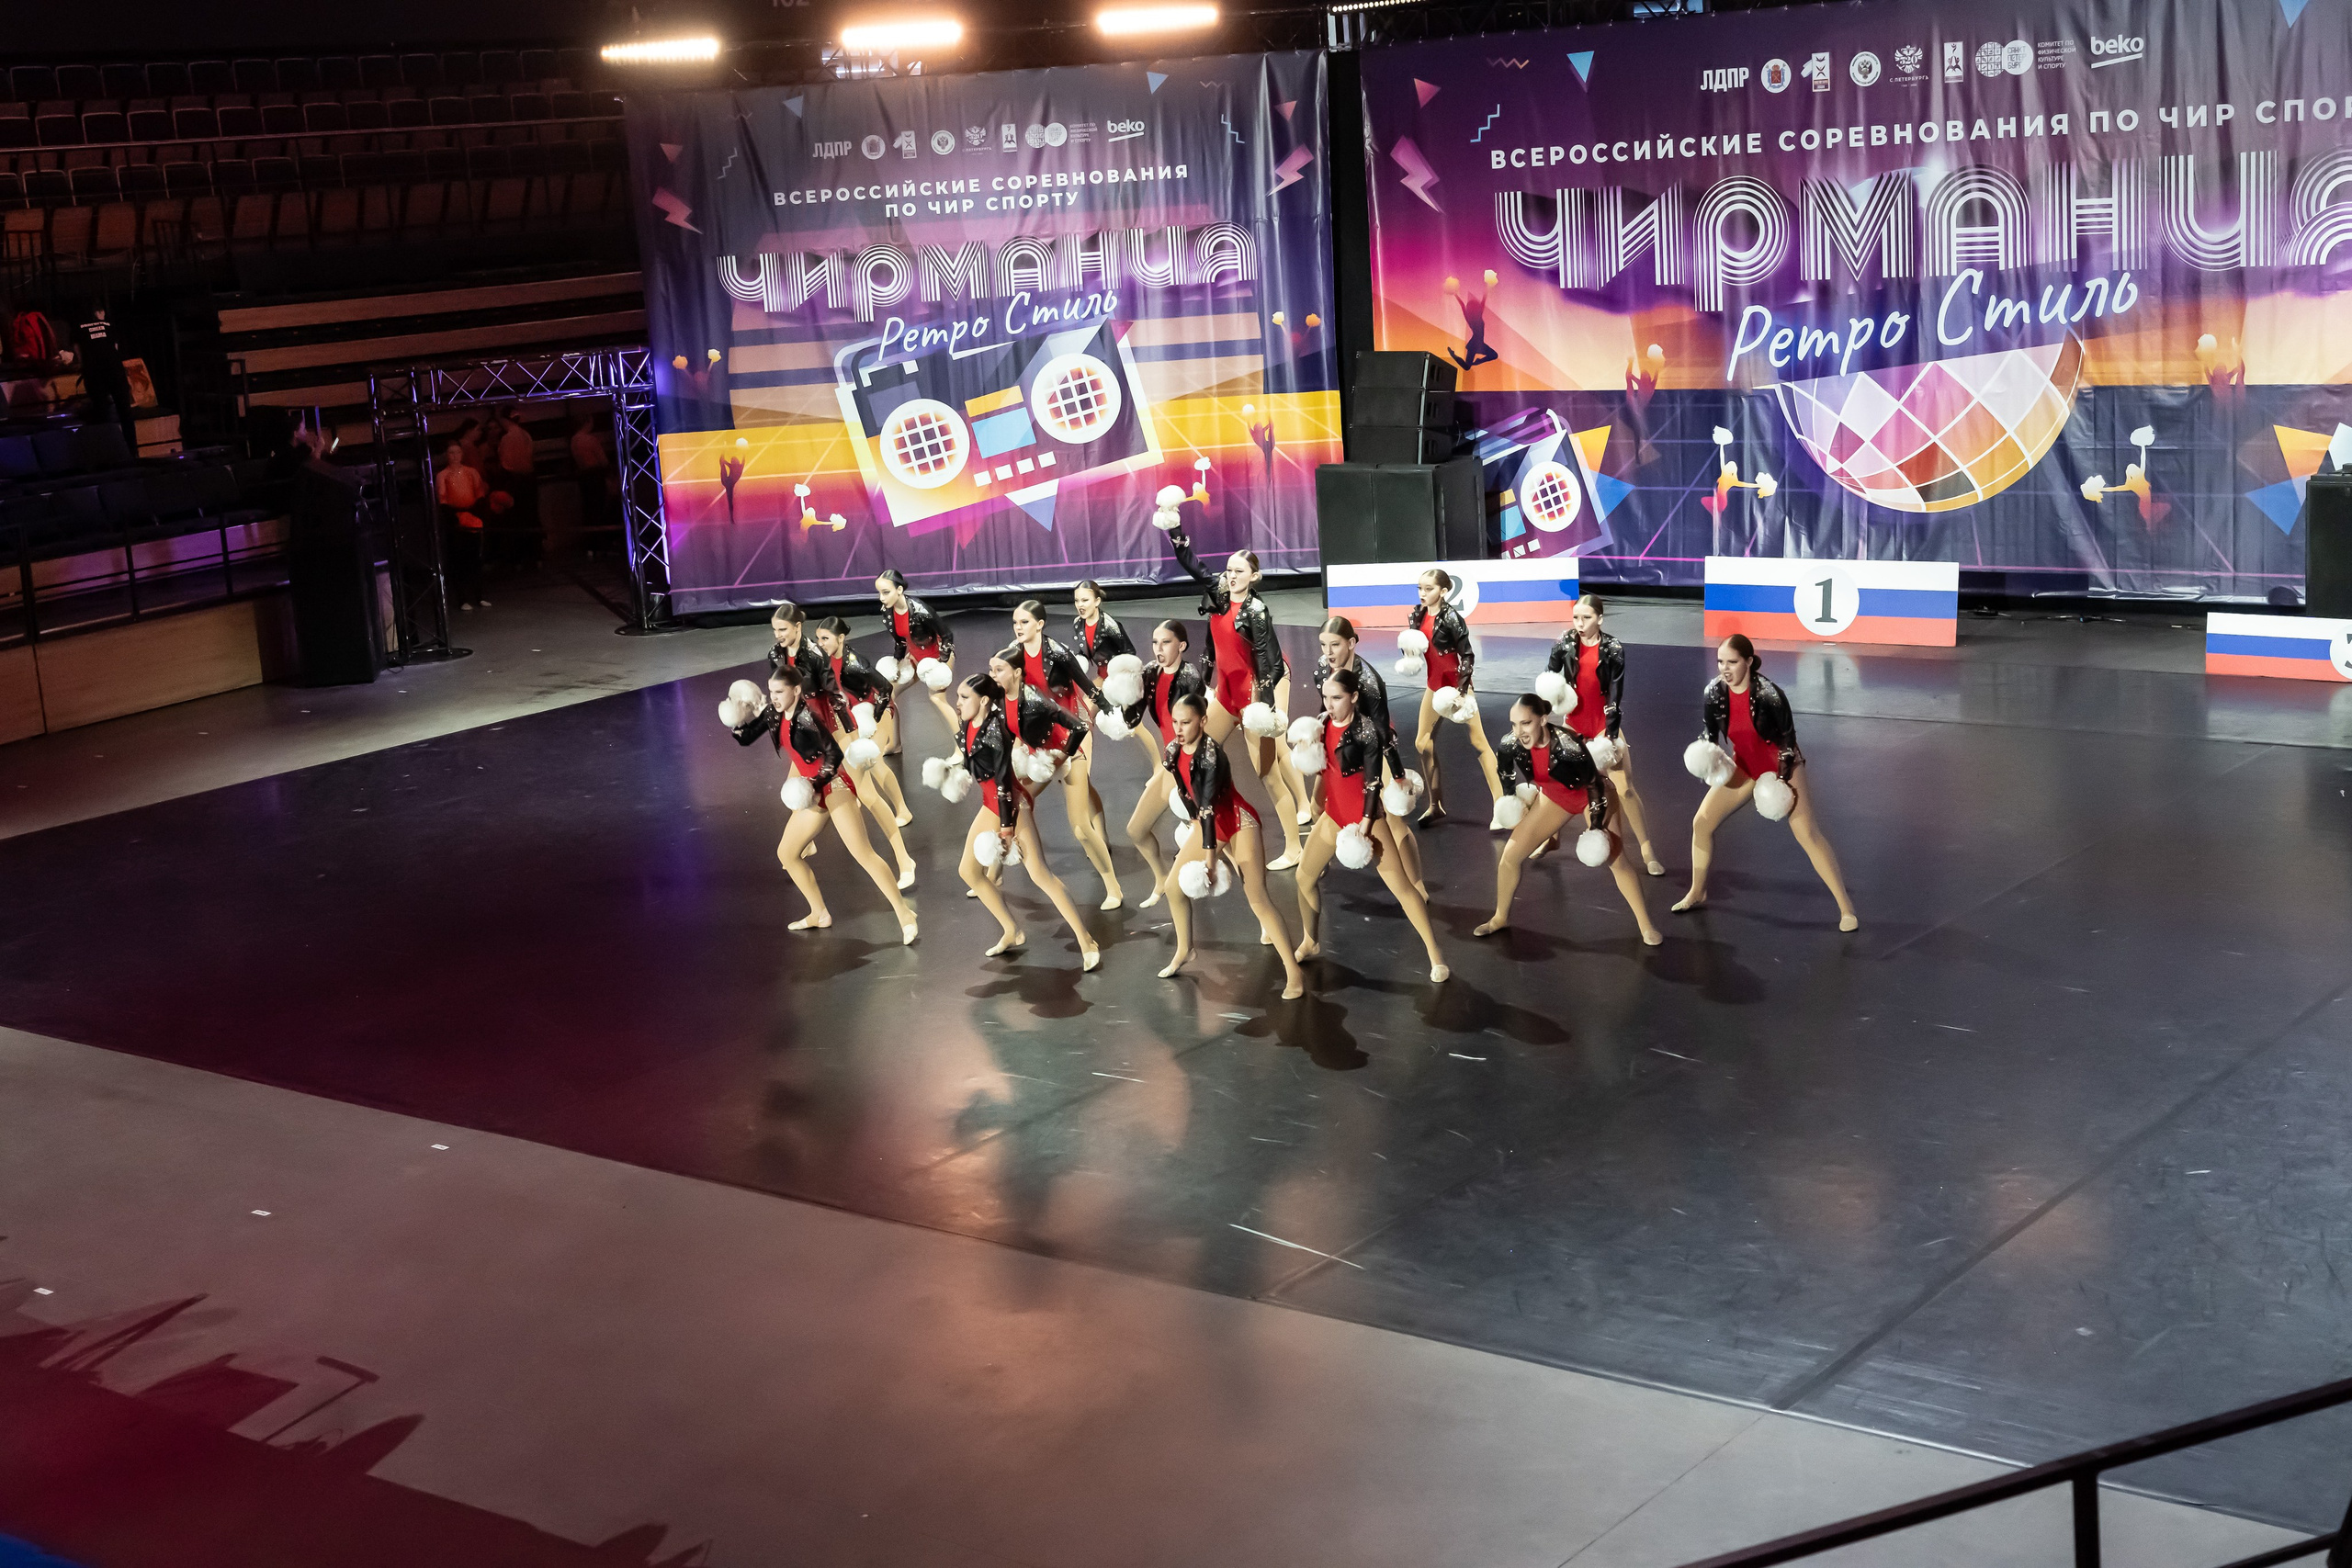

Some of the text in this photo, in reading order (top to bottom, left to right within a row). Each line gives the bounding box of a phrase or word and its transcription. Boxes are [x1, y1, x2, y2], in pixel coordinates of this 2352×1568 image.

[2037, 47, 2076, 55] ФИЗИЧЕСКОЙ
[2090, 34, 2144, 56] beko
[1700, 67, 1749, 92] ЛДПР
[2043, 62, 2066, 70] СПОРТУ
[1106, 118, 1146, 134] beko
[1491, 132, 1762, 170] ВСЕРОССИЙСКИЕ
[1779, 113, 2069, 153] СОРЕВНОВАНИЯ
[2089, 108, 2140, 134] ПО
[2159, 104, 2235, 129] ЧИР
[812, 141, 853, 160] ЛДПР
[774, 164, 1189, 206] ВСЕРОССИЙСКИЕ СОРЕВНОВАНИЯ
[885, 191, 1080, 219] ПО ЧИР СПОРТУ
[878, 290, 1119, 362] Ретро Стиль
[1727, 268, 2140, 382] Ретро Стиль
[1445, 575, 1464, 611] 2
[1815, 578, 1838, 623] 1
